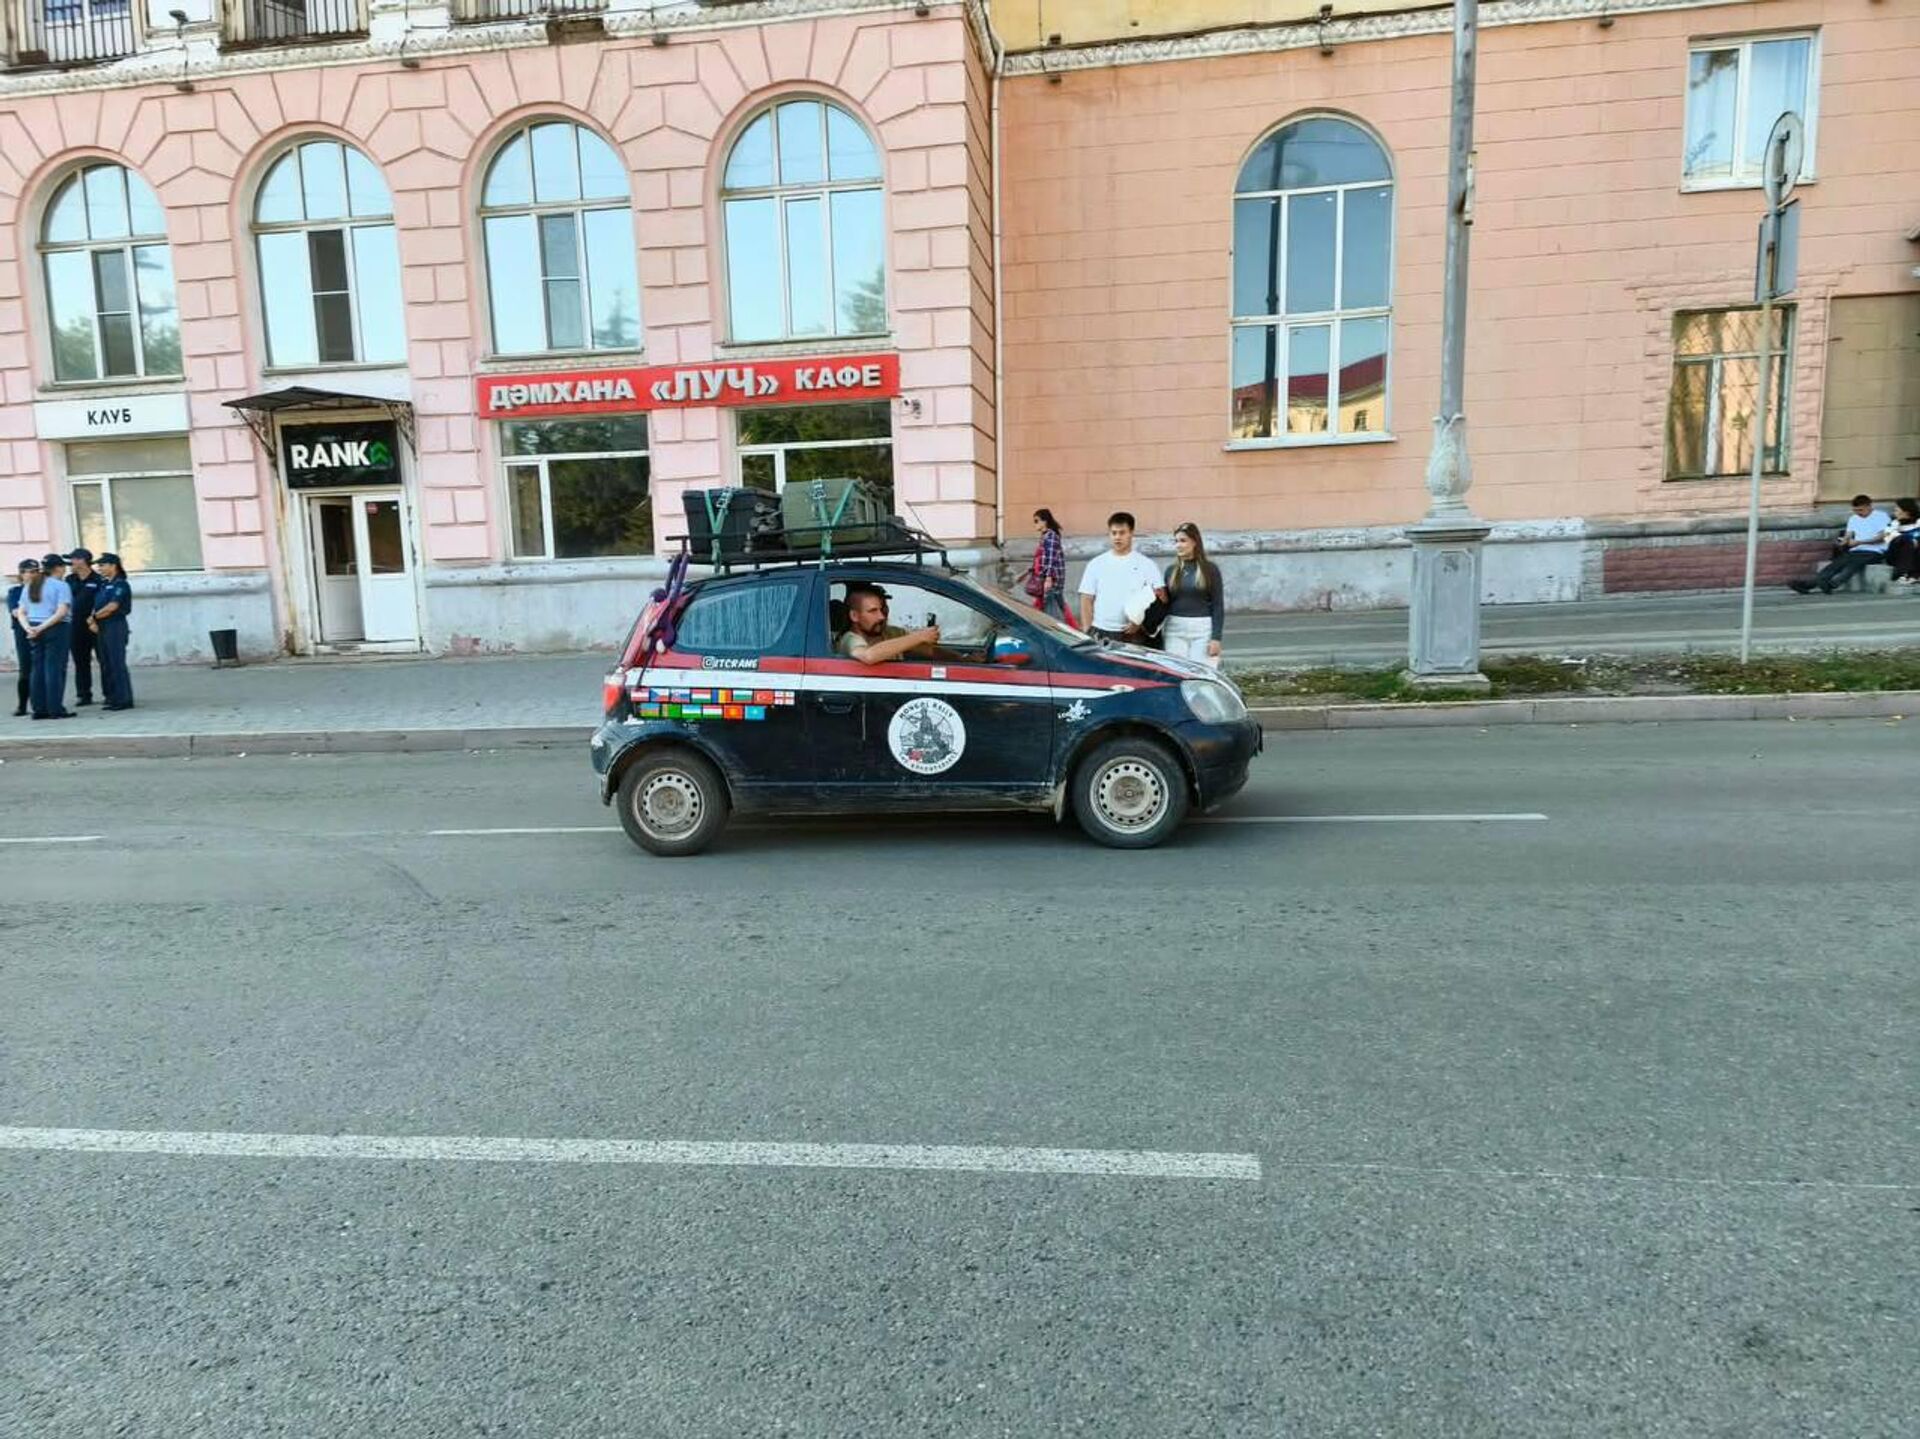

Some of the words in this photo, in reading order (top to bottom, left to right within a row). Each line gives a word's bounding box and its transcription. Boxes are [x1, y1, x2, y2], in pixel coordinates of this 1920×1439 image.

[489, 378, 636, 410] ДӘМХАНА
[650, 367, 780, 401] «ЛУЧ»
[795, 364, 882, 390] КАФЕ
[87, 408, 132, 425] КЛУБ
[290, 440, 371, 469] RANK
